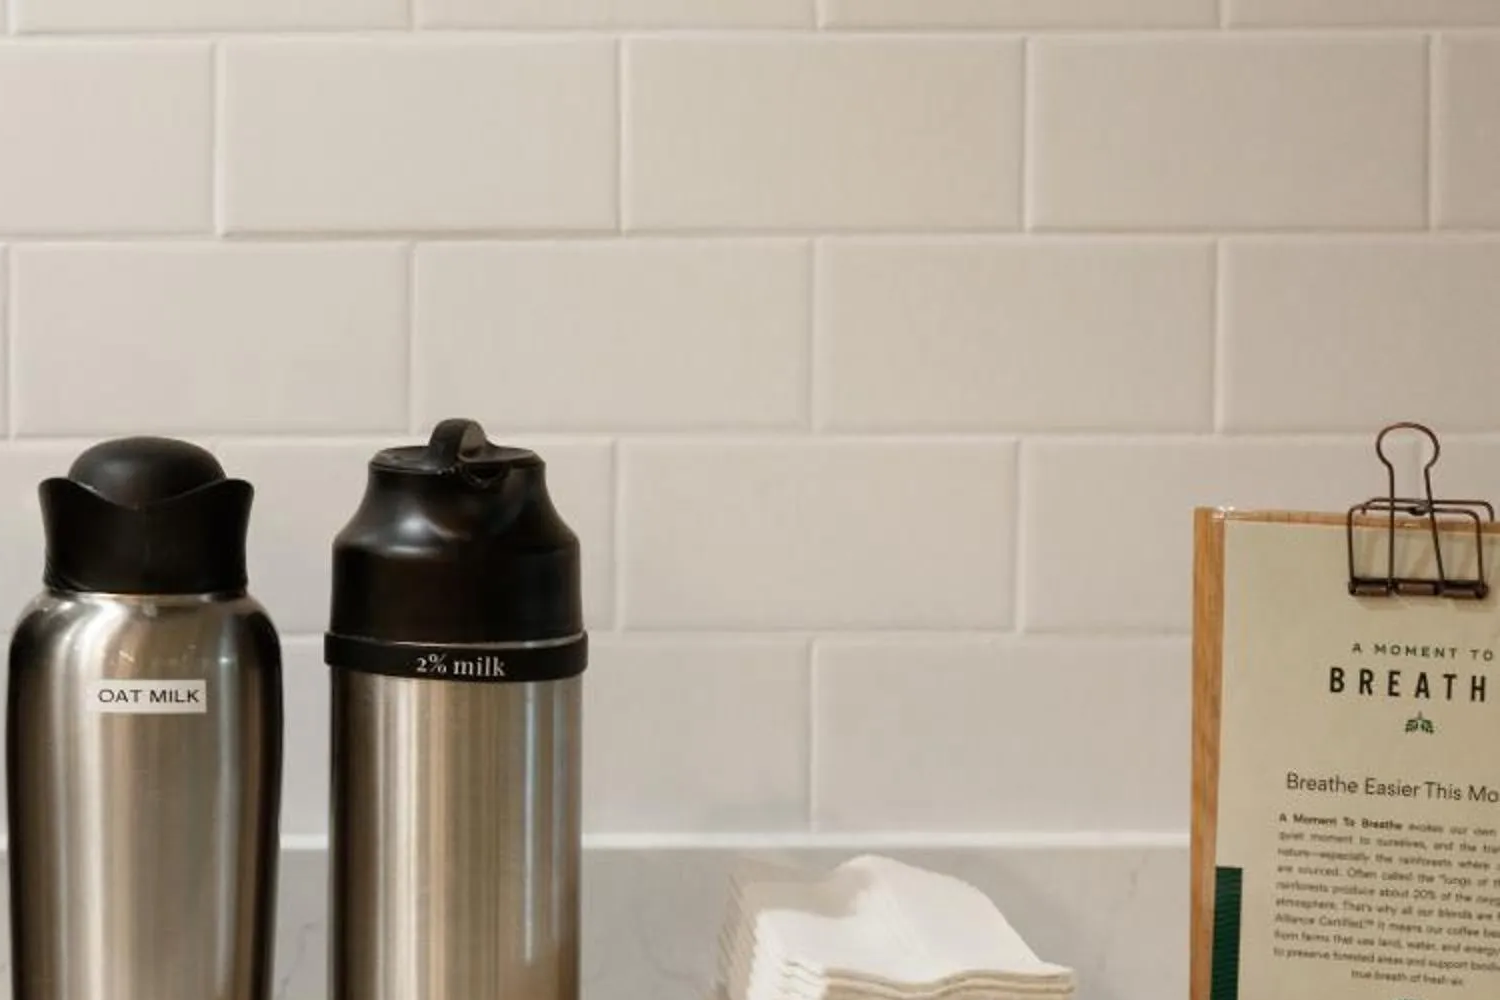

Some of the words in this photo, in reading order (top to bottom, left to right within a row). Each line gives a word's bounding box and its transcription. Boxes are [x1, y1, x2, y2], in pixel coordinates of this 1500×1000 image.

[1352, 642, 1363, 654] A
[1373, 643, 1457, 659] MOMENT
[1469, 648, 1494, 661] TO
[416, 653, 447, 674] 2%
[453, 656, 506, 677] milk
[1328, 666, 1487, 702] BREATH
[98, 689, 143, 703] OAT
[149, 688, 200, 703] MILK
[1286, 771, 1358, 794] Breathe
[1364, 777, 1420, 798] Easier
[1424, 780, 1461, 801] This
[1280, 814, 1287, 822] A
[1294, 814, 1336, 826] Moment
[1362, 818, 1402, 830] Breathe
